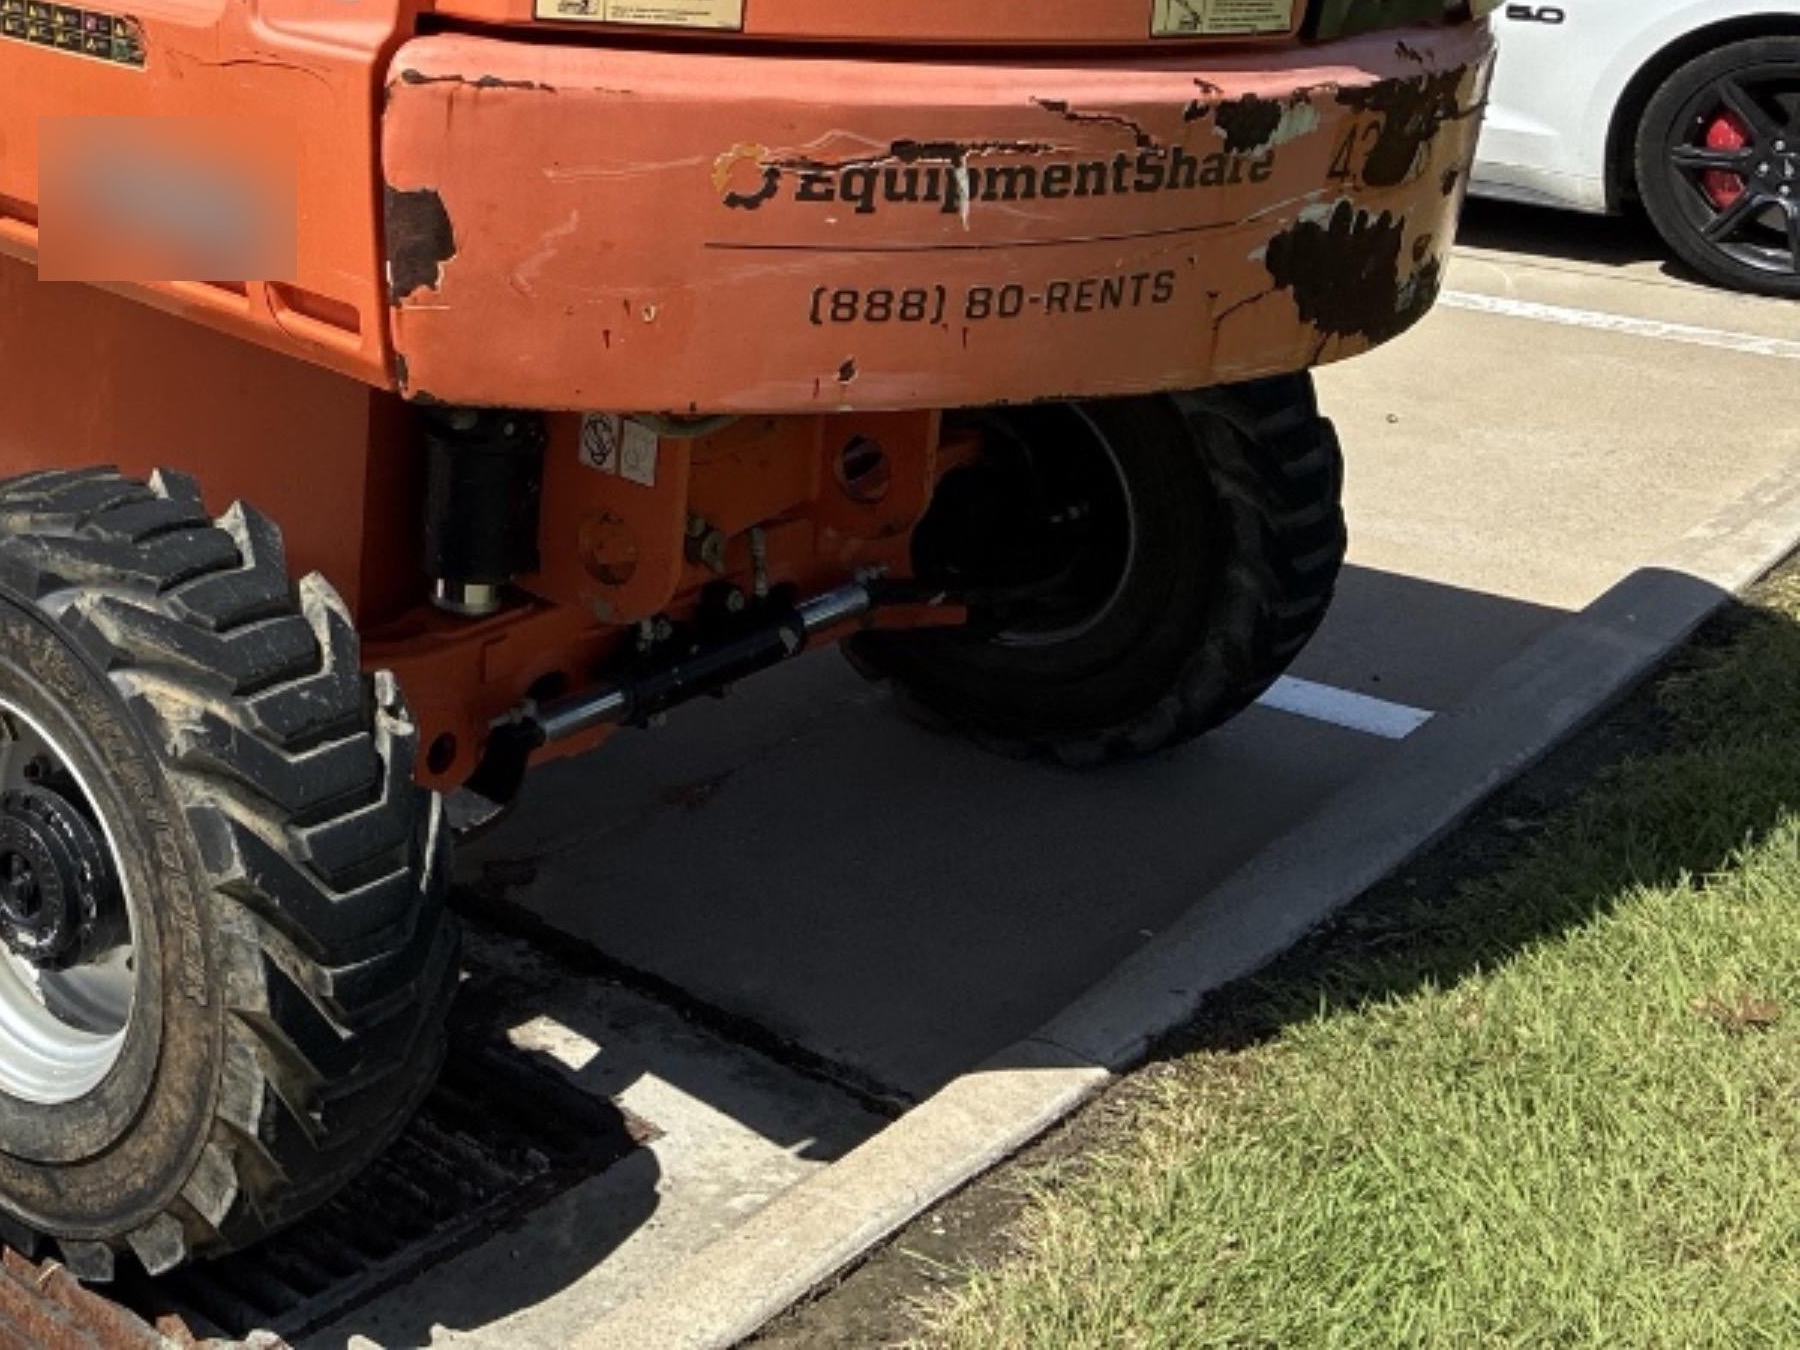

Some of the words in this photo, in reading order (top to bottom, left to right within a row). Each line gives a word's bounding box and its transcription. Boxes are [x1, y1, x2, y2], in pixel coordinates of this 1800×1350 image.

[1505, 3, 1565, 25] 5.0
[794, 147, 1276, 214] EquipmentShare
[809, 283, 946, 326] (888)
[964, 268, 1178, 321] 80-RENTS
